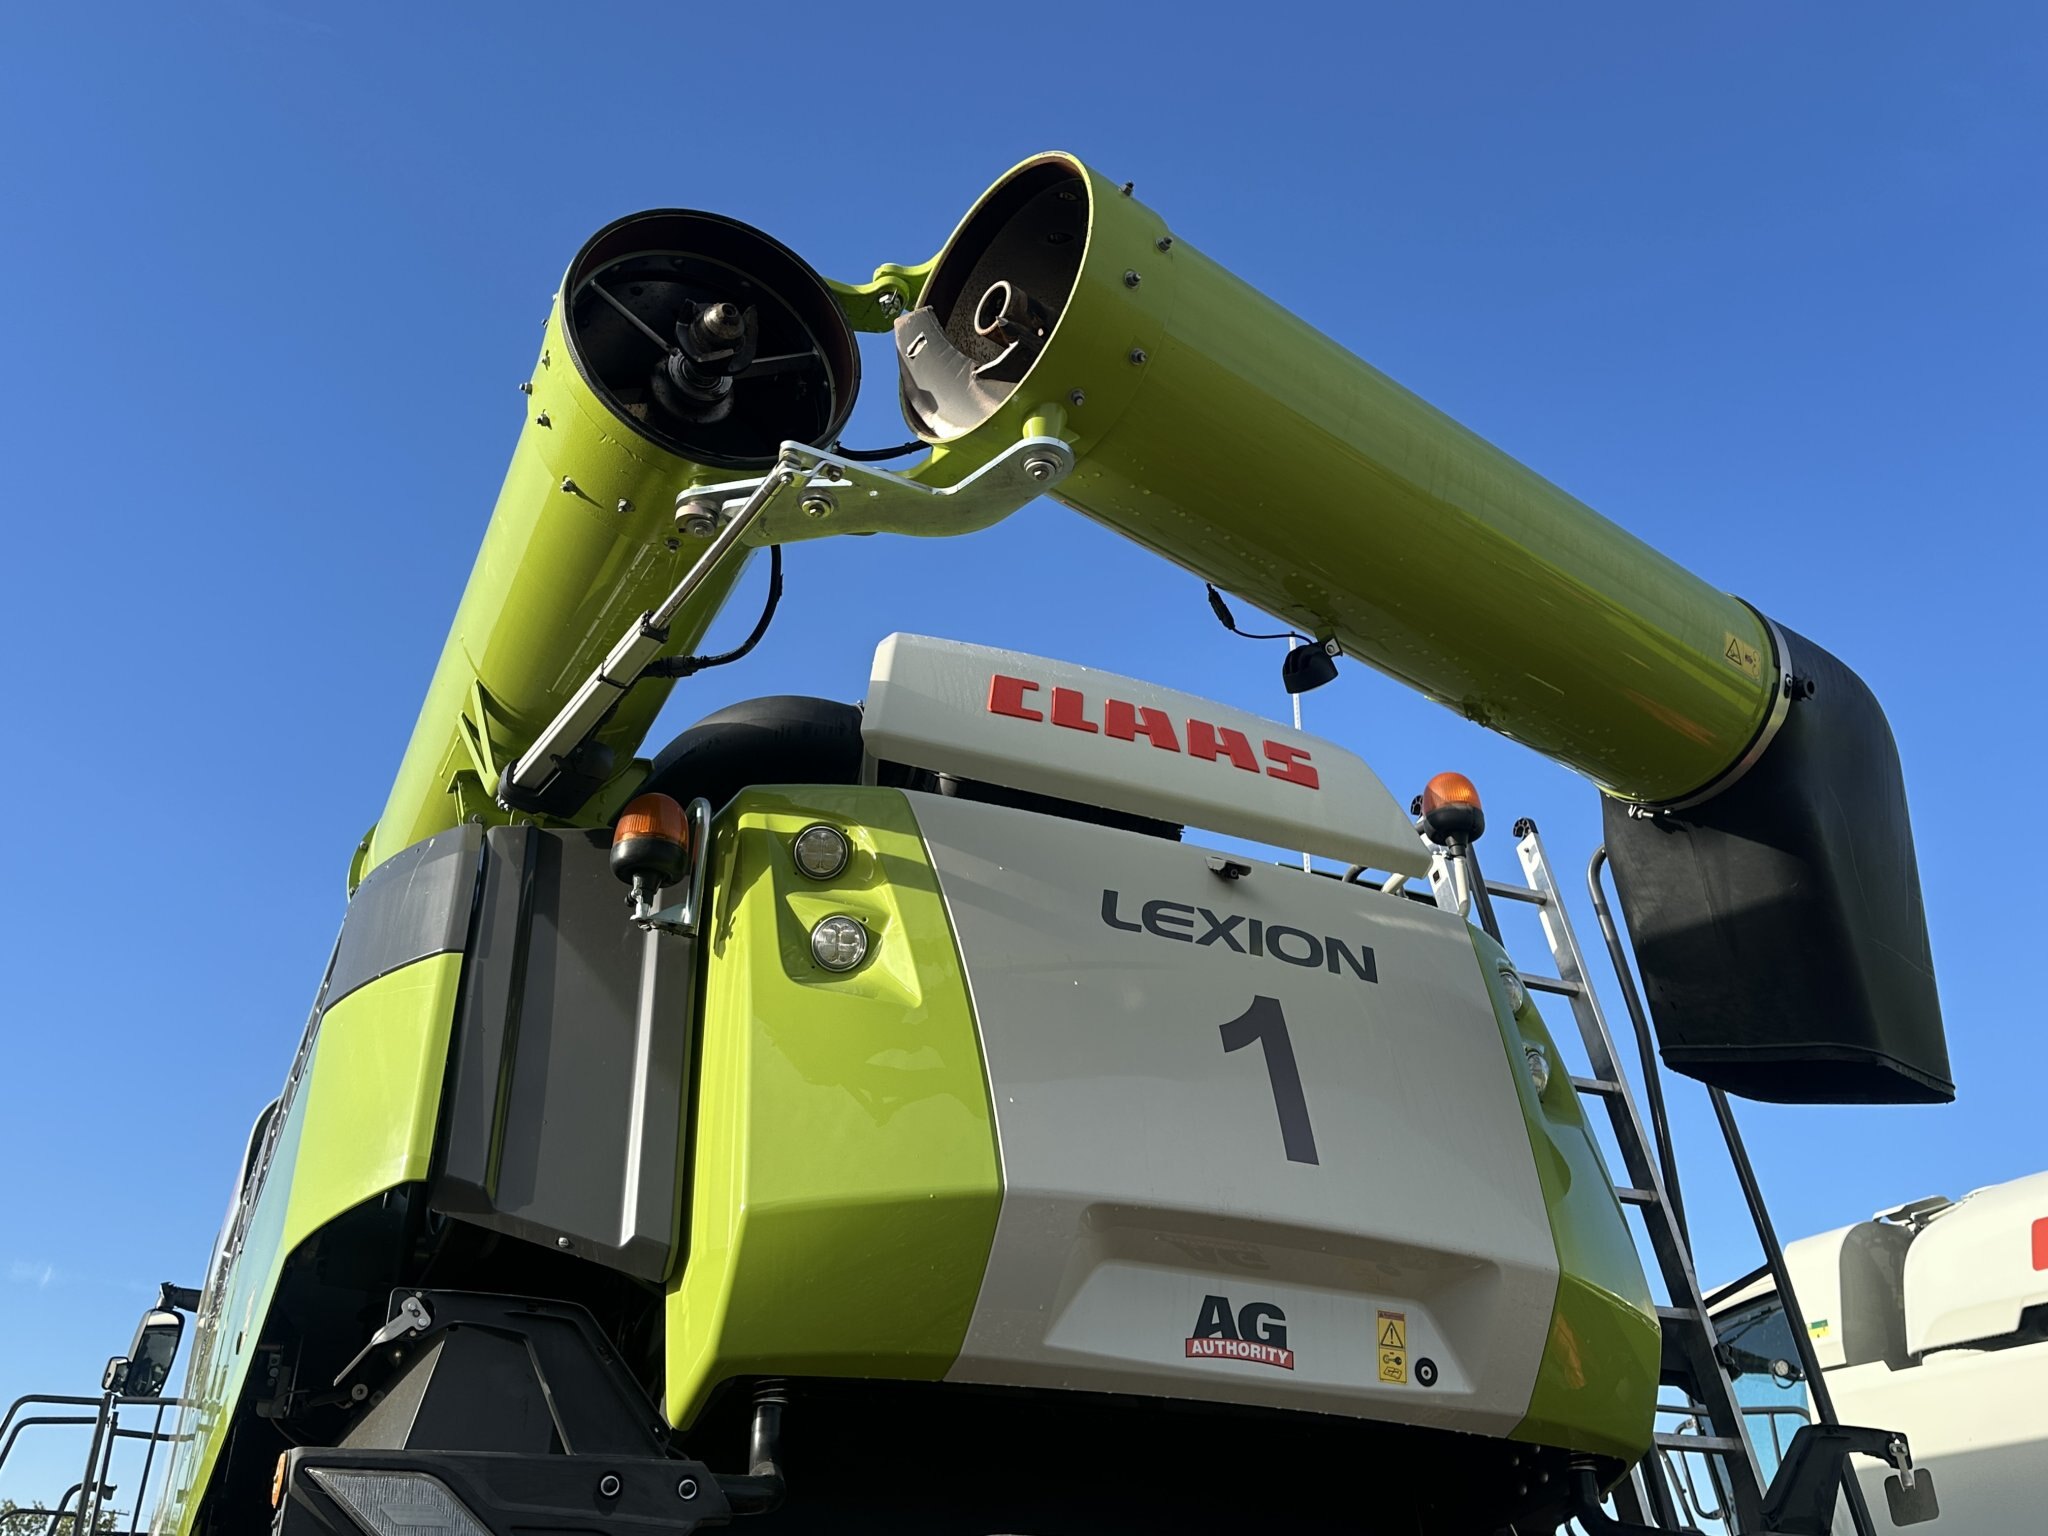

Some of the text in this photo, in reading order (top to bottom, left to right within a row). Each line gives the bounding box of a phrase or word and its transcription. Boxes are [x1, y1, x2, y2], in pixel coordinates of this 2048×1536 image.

[988, 674, 1320, 789] CLAAS
[1101, 889, 1378, 984] LEXION
[1219, 994, 1320, 1165] 1
[1191, 1340, 1289, 1364] AUTHORITY
[1192, 1294, 1287, 1350] AG
